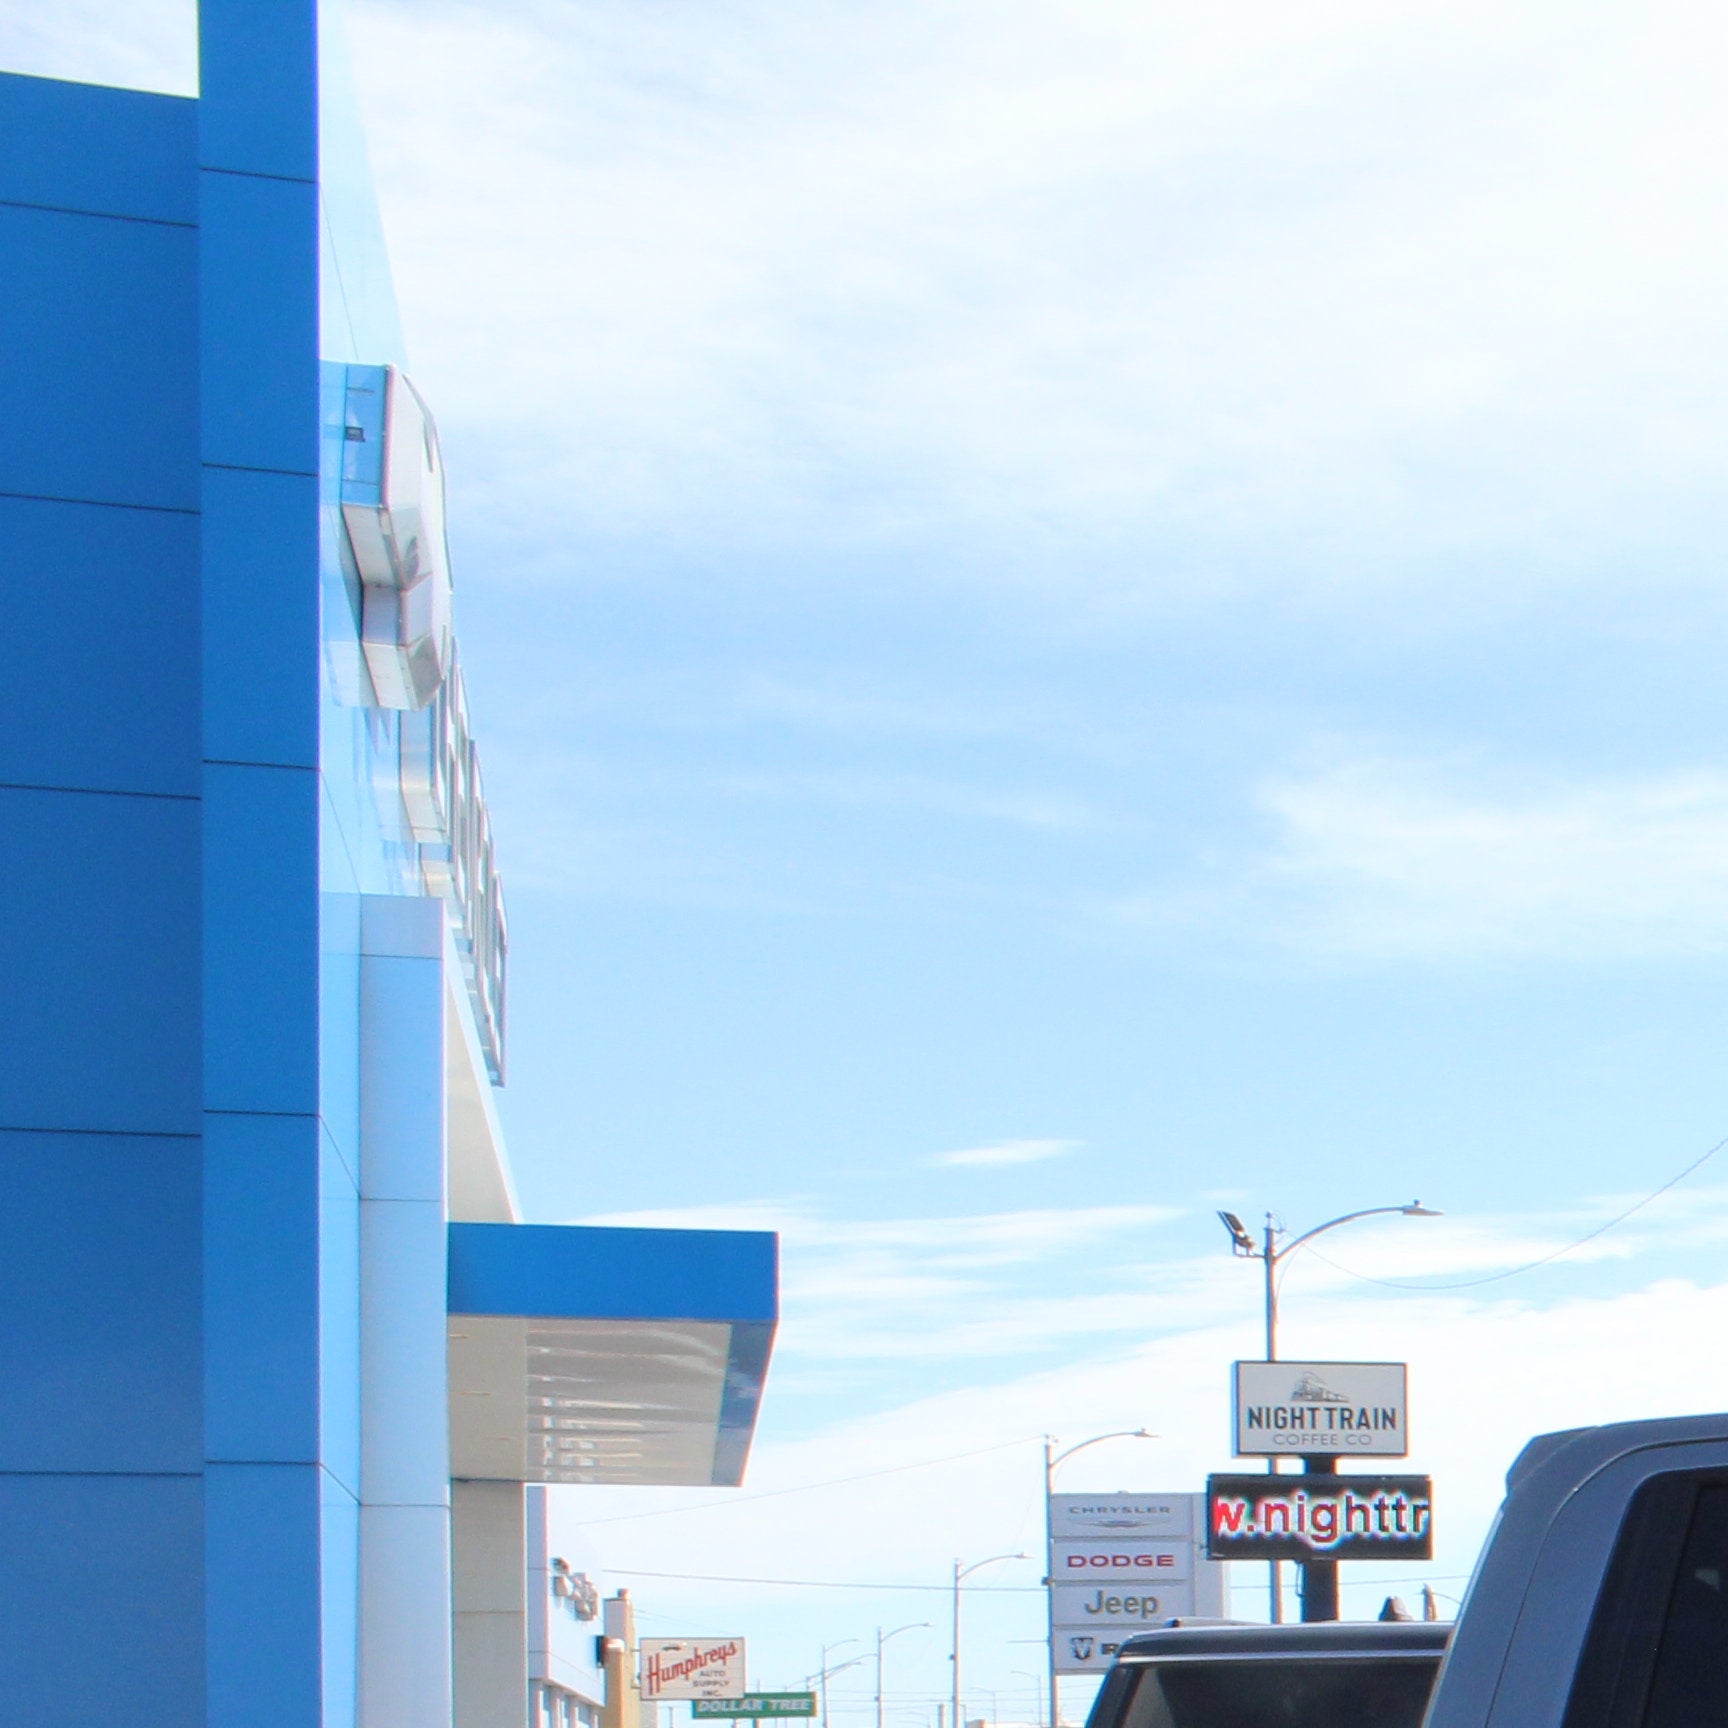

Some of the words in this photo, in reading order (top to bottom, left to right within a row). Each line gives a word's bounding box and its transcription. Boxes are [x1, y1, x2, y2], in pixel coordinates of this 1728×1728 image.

[1247, 1406, 1320, 1430] NIGHT
[1323, 1406, 1397, 1430] TRAIN
[1273, 1433, 1338, 1446] COFFEE
[1346, 1433, 1373, 1446] CO
[1069, 1506, 1171, 1514] CHRYSLER
[1067, 1555, 1174, 1567] DODGE
[1085, 1591, 1159, 1618] Jeep
[648, 1641, 737, 1695] Humphreys
[697, 1700, 762, 1711] DOLLAR
[769, 1699, 811, 1711] TREE
